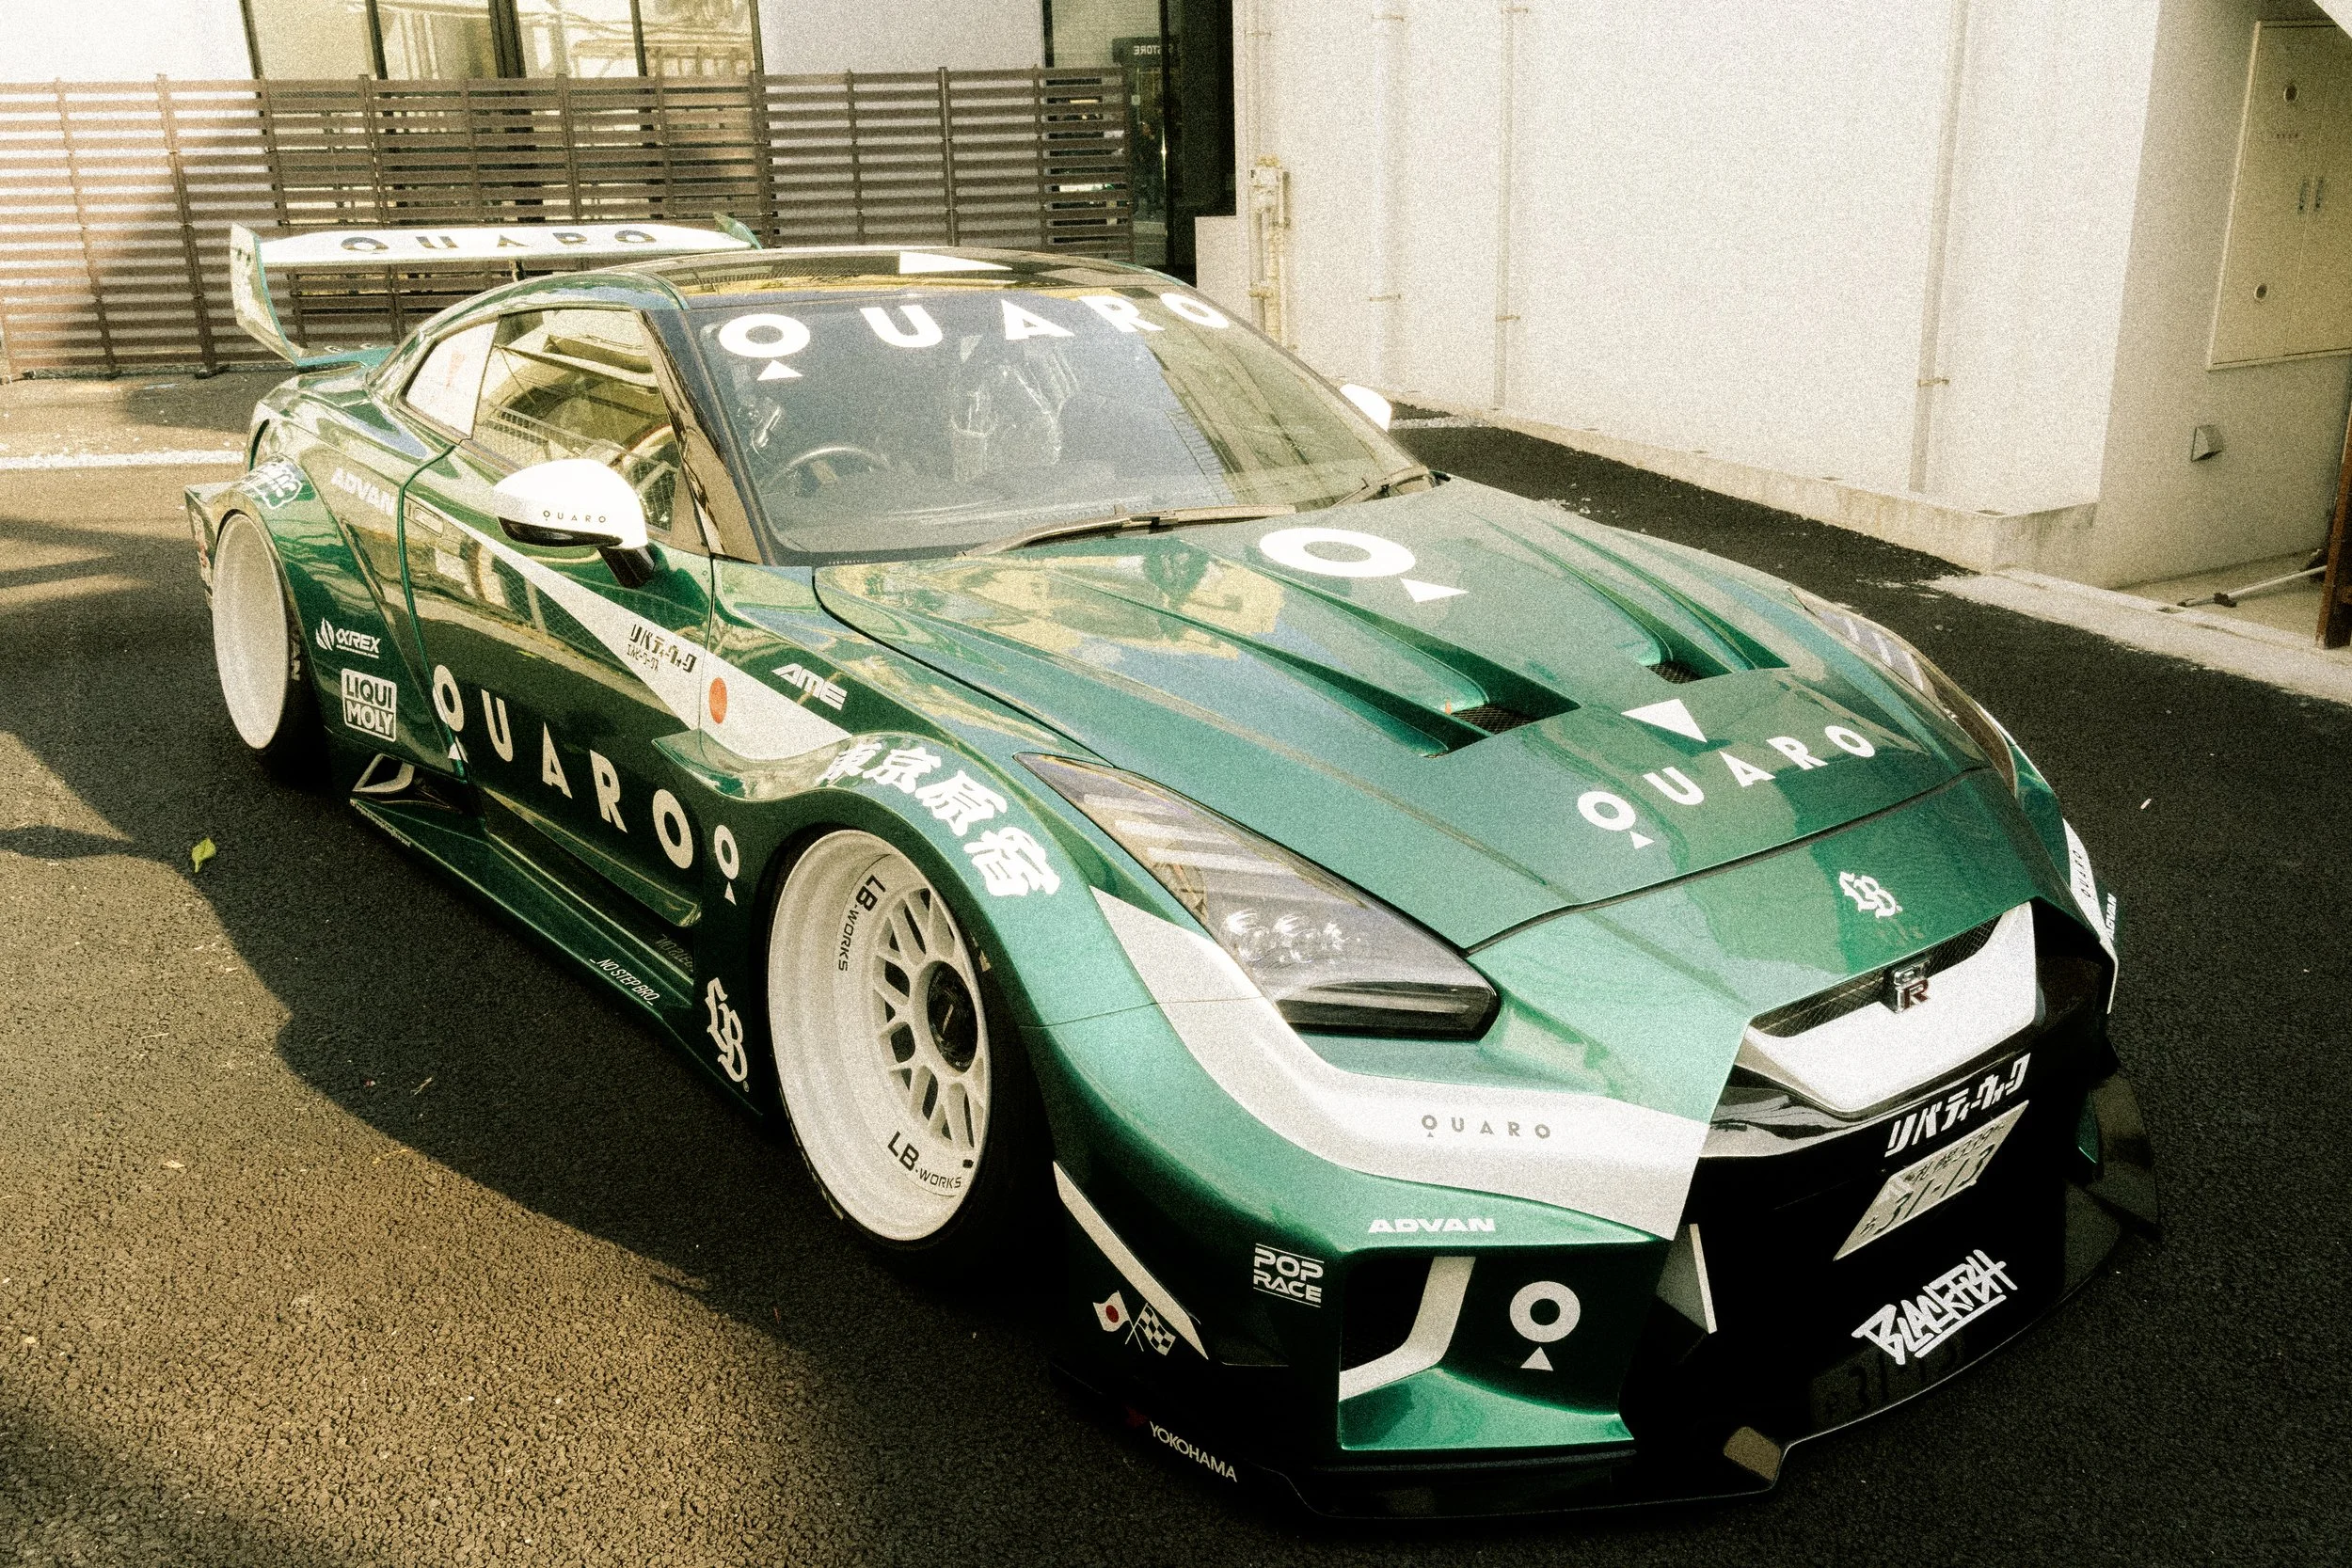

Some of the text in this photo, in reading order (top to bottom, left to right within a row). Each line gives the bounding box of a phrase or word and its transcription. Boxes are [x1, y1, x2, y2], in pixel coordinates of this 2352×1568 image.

[718, 292, 1230, 381] QUARO
[330, 467, 396, 517] ADVAN
[542, 510, 607, 524] QUARO
[345, 673, 393, 710] LIQUI
[771, 662, 848, 712] AME
[345, 701, 393, 736] MOLY
[432, 664, 694, 869] QUARO
[1576, 725, 1876, 849] QUARO
[610, 968, 642, 987] STEP
[1421, 1114, 1551, 1139] QUARO
[1883, 1052, 2030, 1158] リバティーウォーク
[1873, 1143, 1997, 1237] 31-13
[1367, 1217, 1496, 1233] ADVAN
[1253, 1247, 1324, 1281] POP
[1253, 1269, 1322, 1304] RACE
[1149, 1419, 1238, 1483] YOKOHAMA
